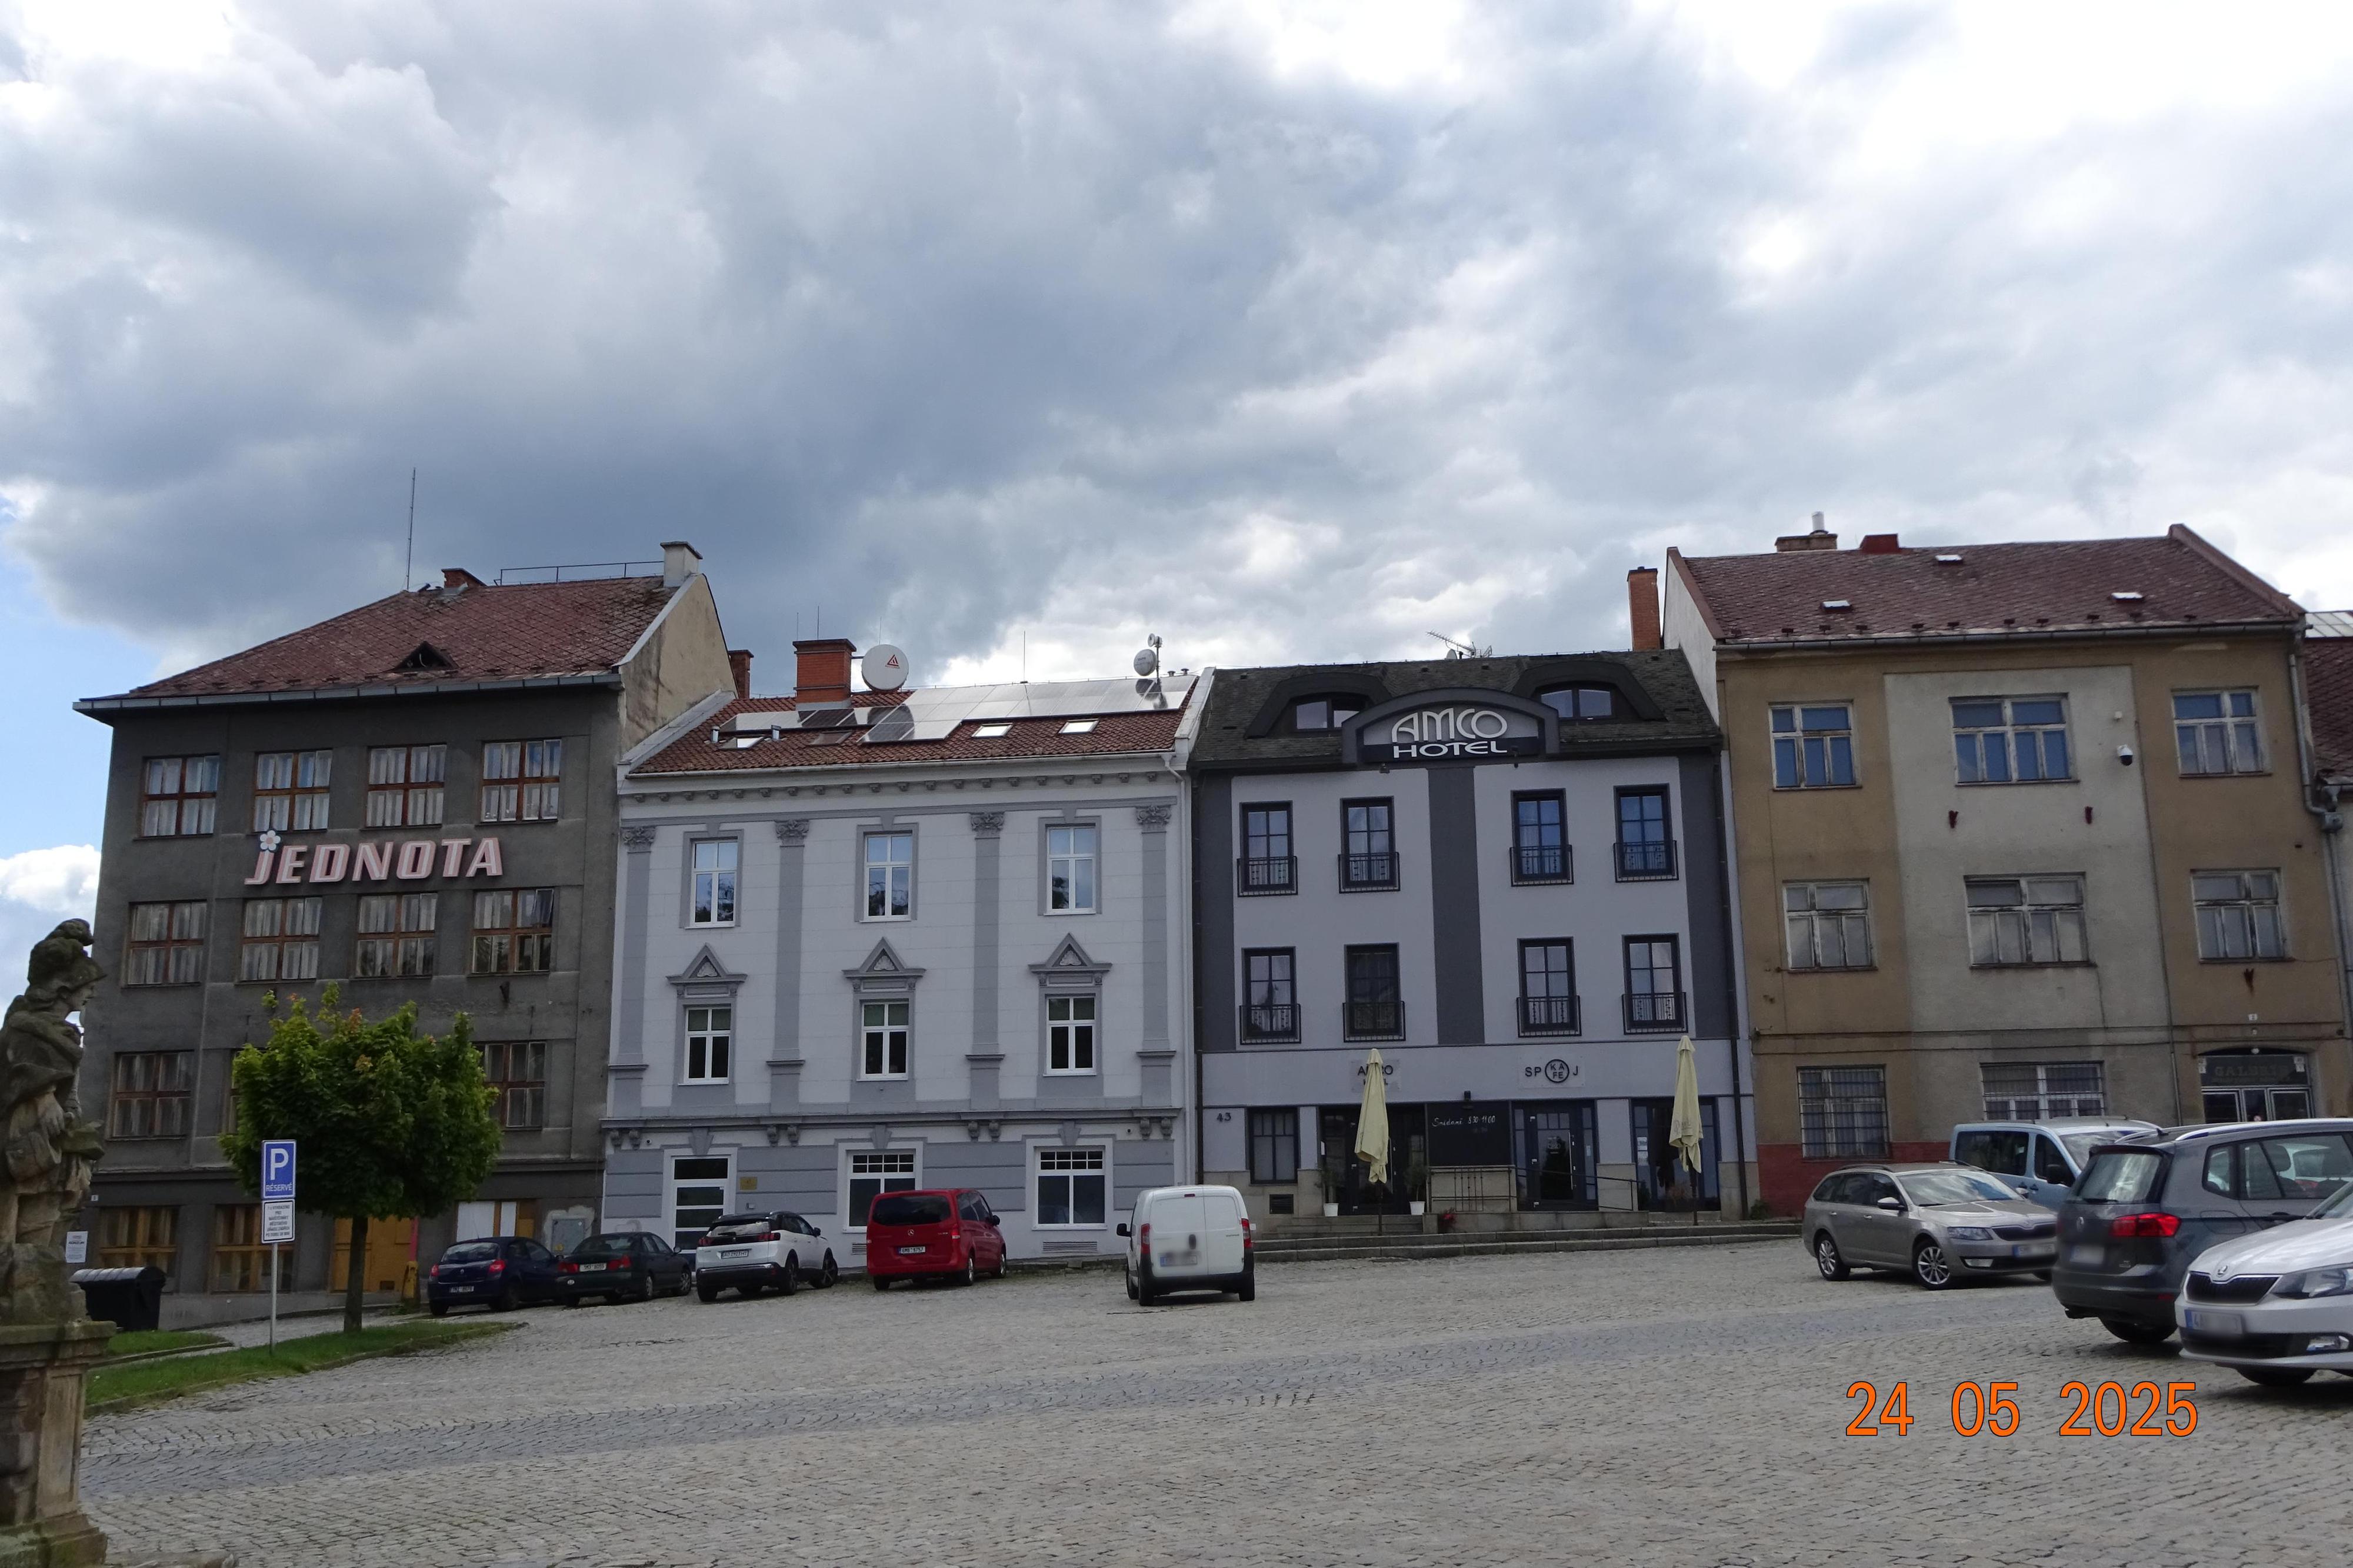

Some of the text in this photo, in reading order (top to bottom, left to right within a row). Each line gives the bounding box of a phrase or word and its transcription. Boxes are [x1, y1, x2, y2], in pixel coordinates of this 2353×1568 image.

[1392, 708, 1507, 743] AMCO
[1394, 741, 1507, 758] HOTEL
[244, 837, 503, 885] JEDNOTA
[1217, 1113, 1231, 1122] 43
[271, 1148, 288, 1180] P
[266, 1182, 292, 1192] RÉSERVÉ
